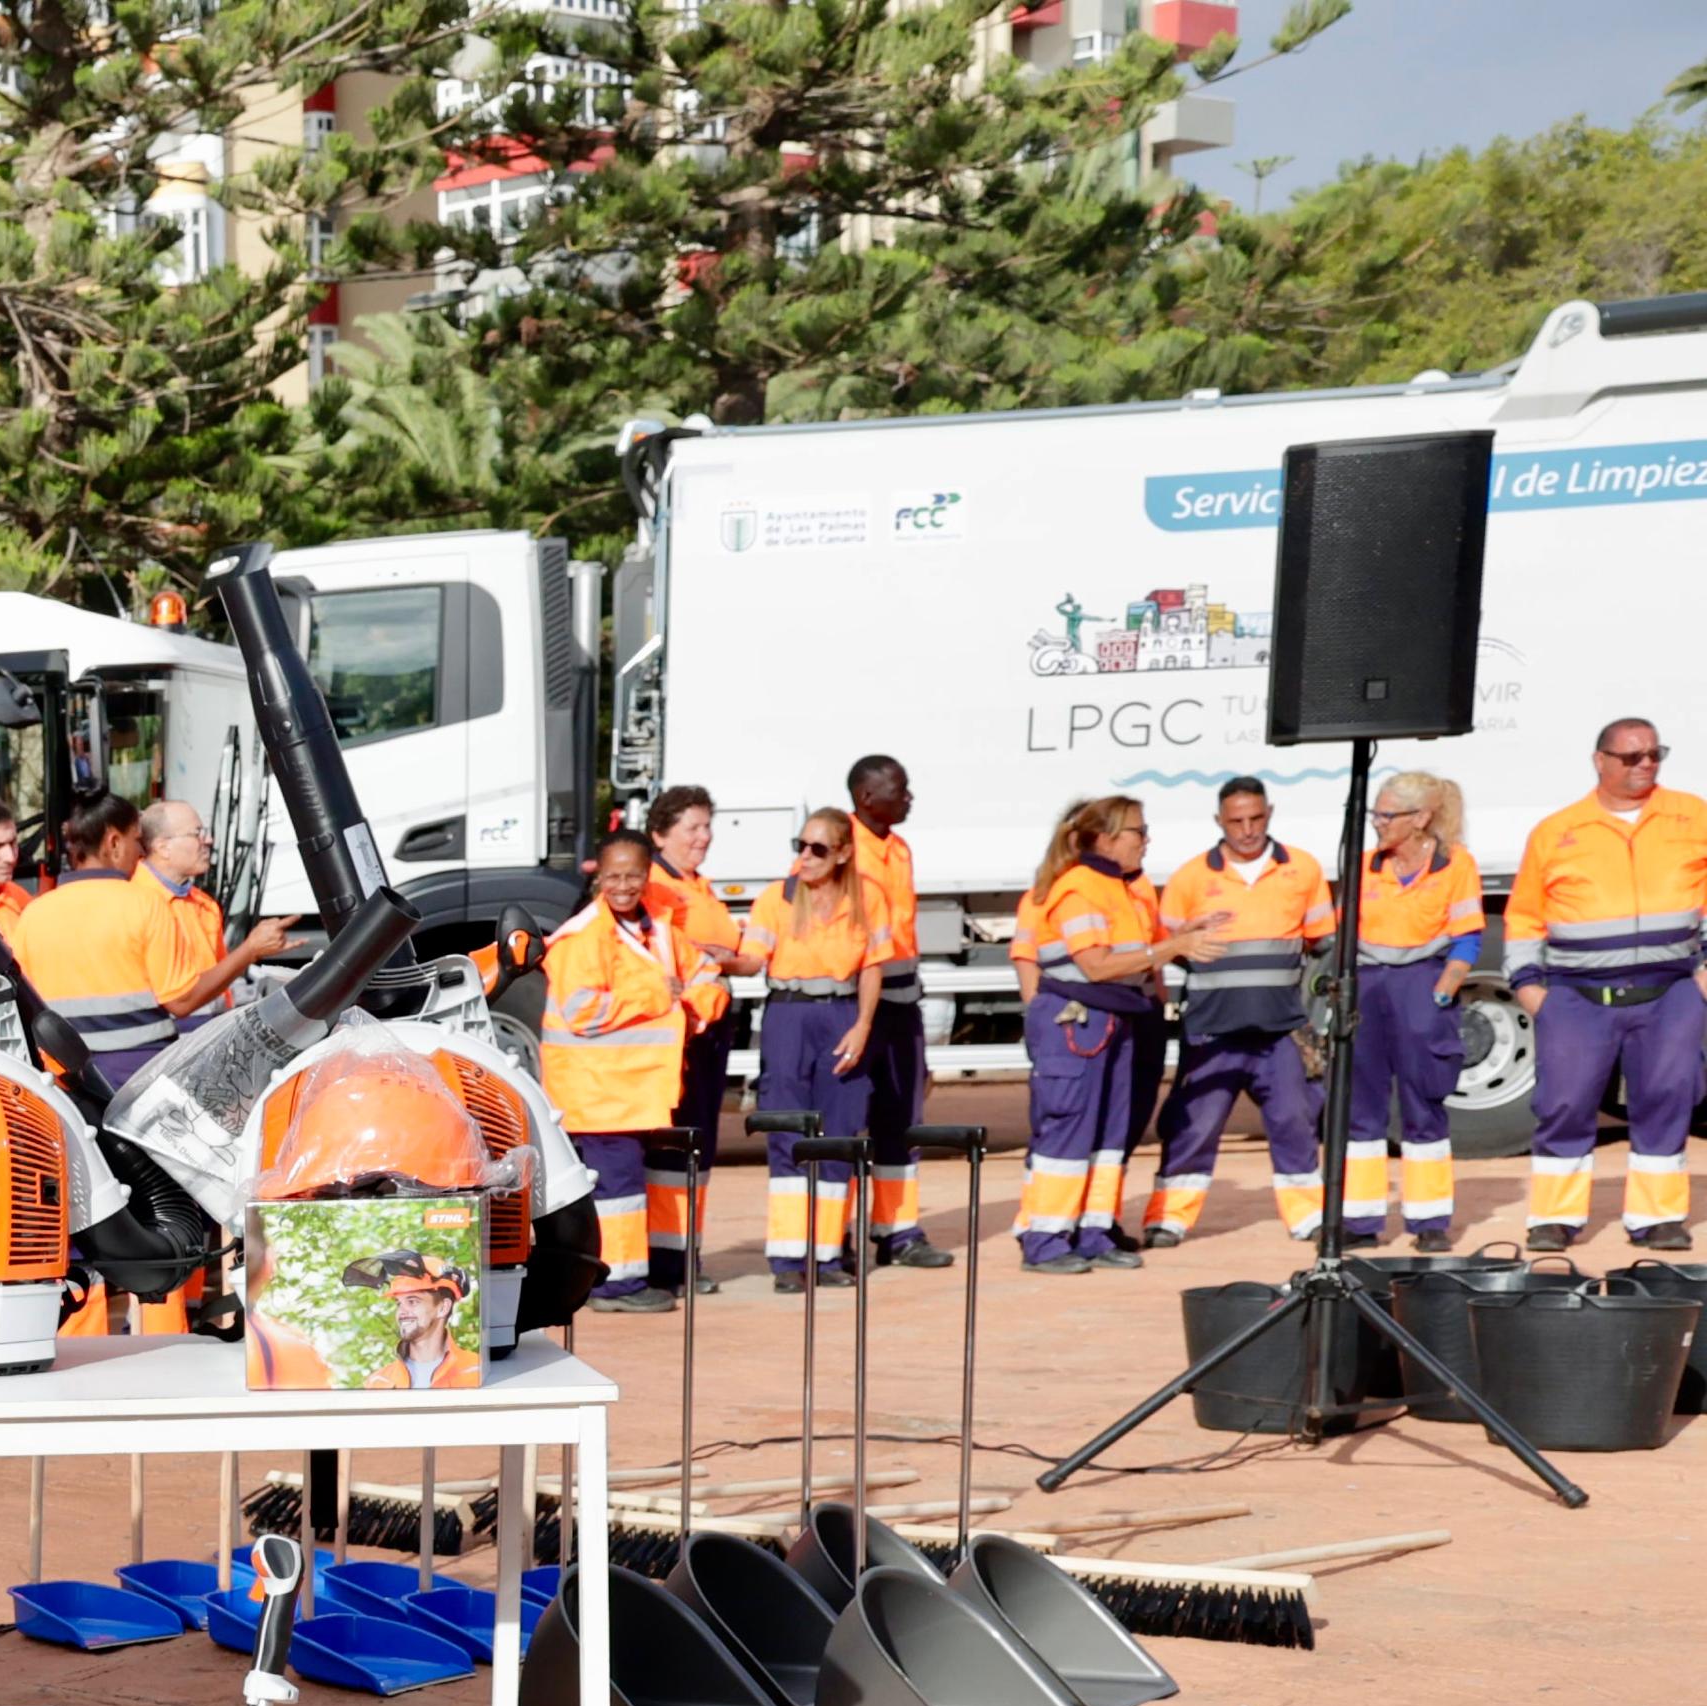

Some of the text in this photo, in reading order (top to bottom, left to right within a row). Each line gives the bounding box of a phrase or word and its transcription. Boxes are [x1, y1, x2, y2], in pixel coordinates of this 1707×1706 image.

[1523, 461, 1558, 498] de
[1566, 452, 1707, 498] Limpiez
[1172, 480, 1283, 519] Servic
[1027, 699, 1205, 752] LPGC
[1222, 695, 1258, 717] TU
[428, 1213, 465, 1225] STIHL
